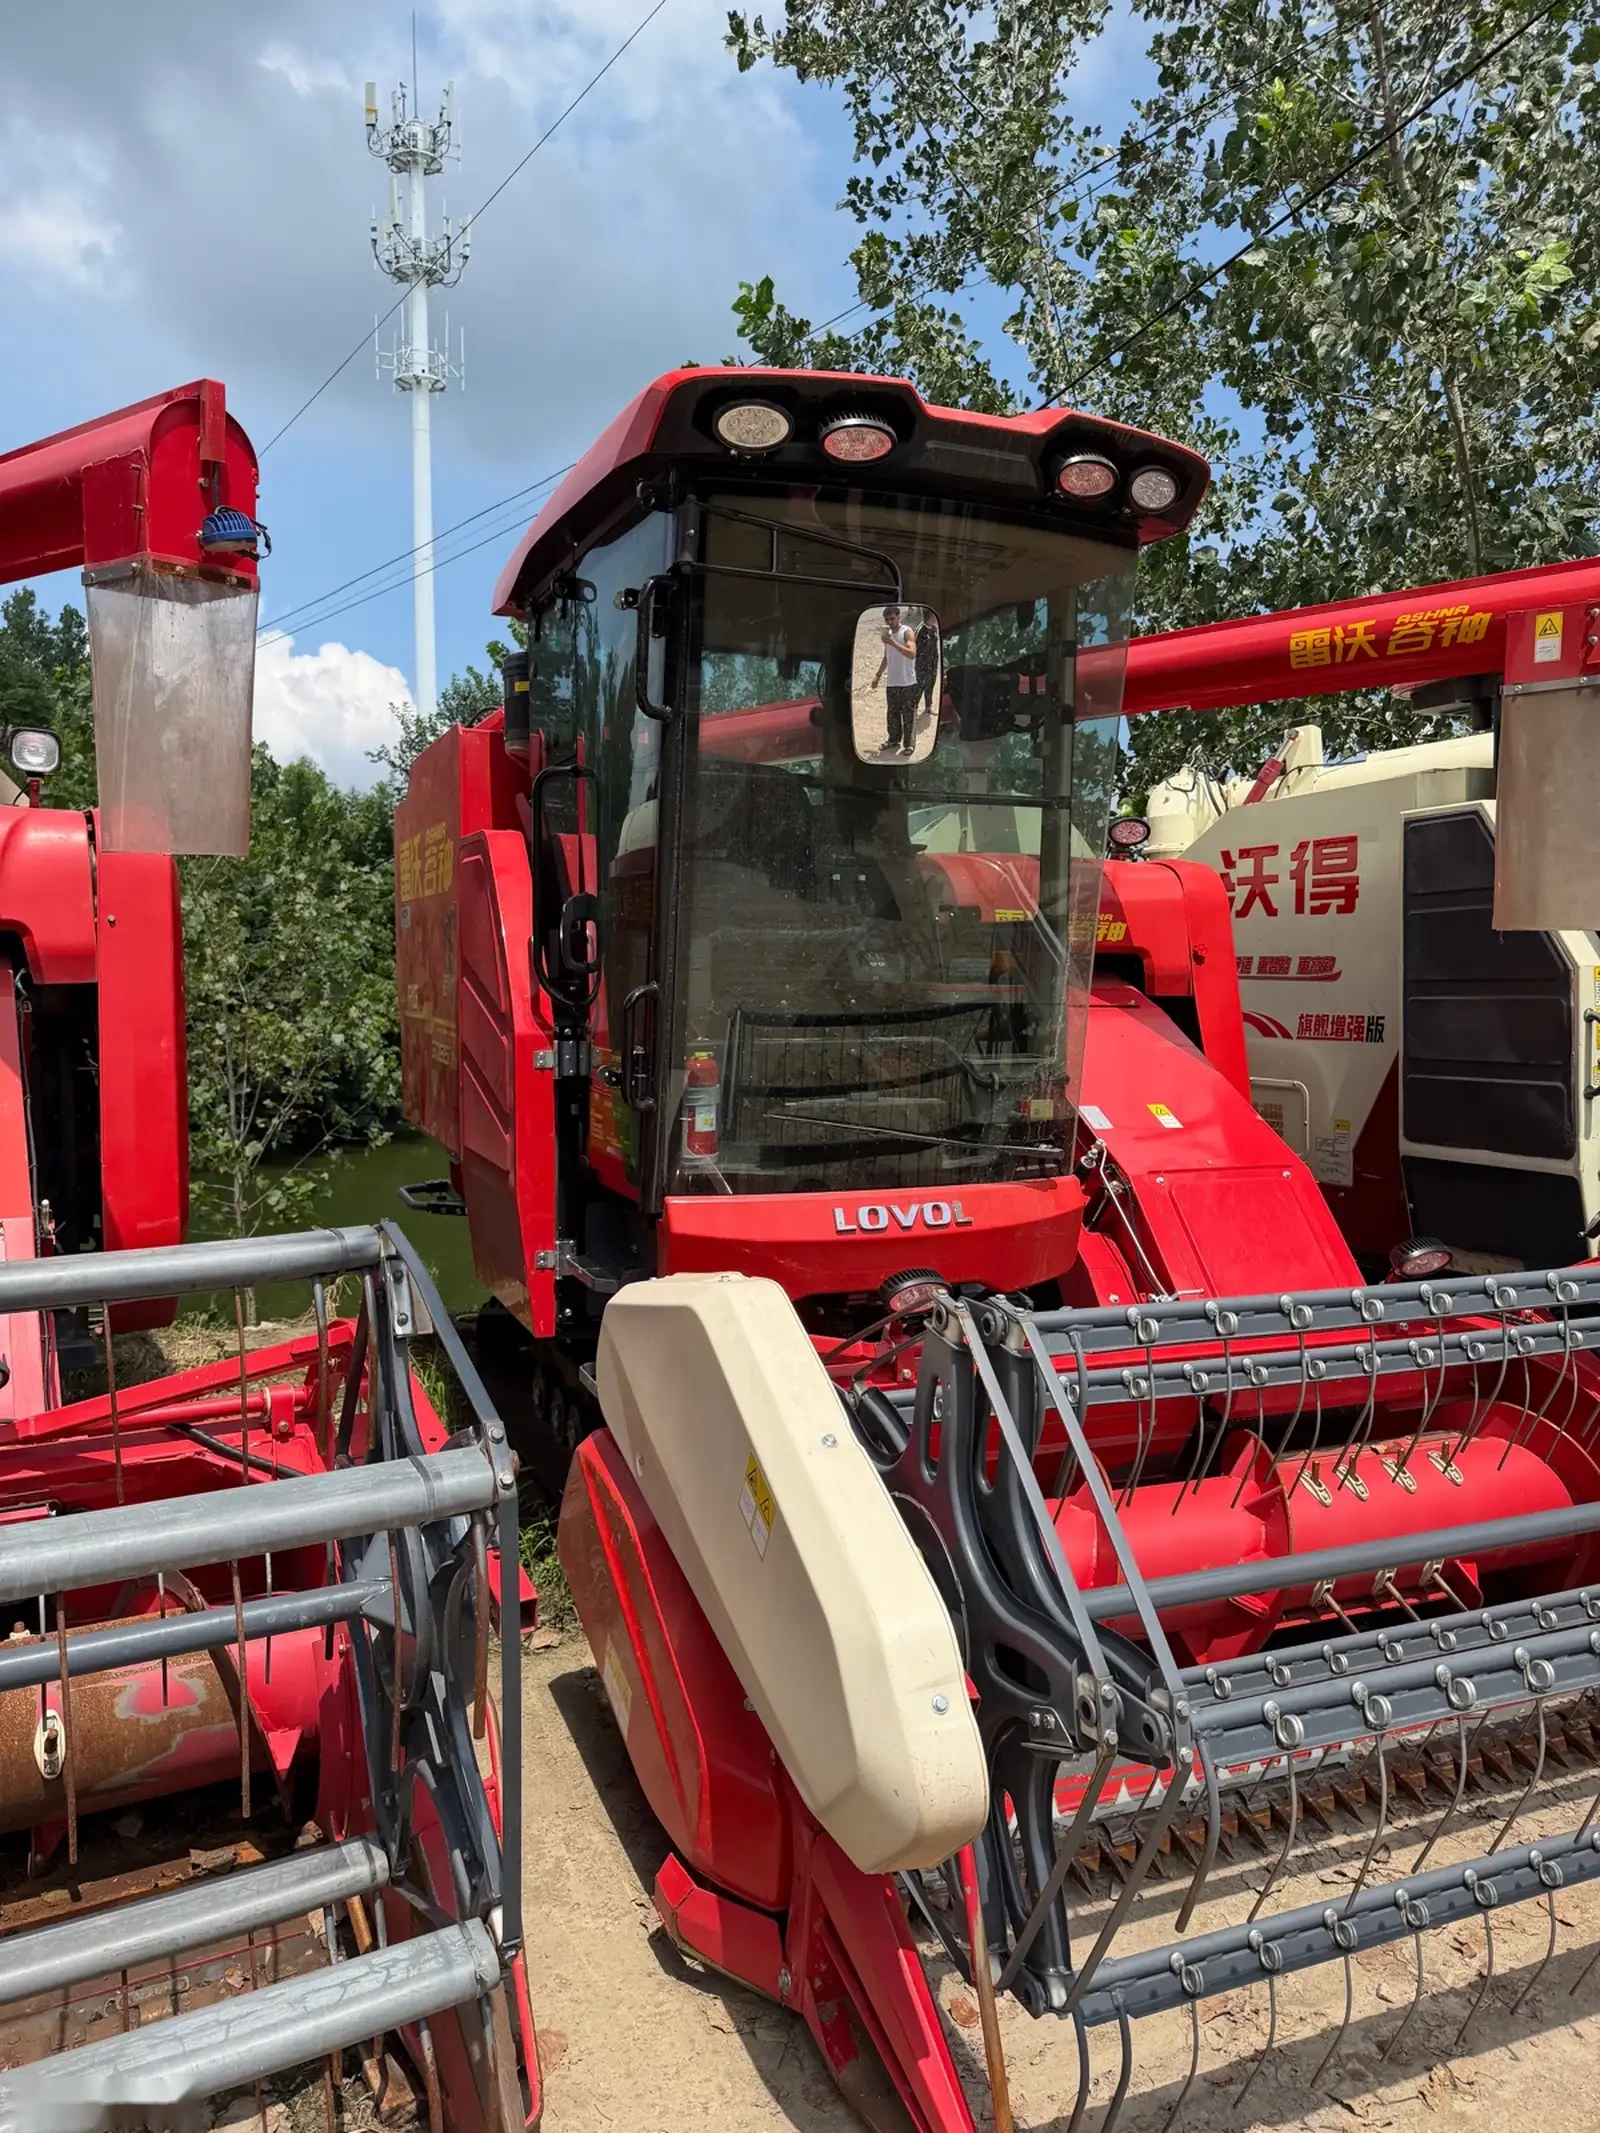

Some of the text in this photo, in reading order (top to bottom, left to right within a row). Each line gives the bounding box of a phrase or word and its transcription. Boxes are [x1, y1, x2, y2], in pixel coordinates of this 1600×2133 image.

[1395, 605, 1470, 625] ASHNA
[1289, 612, 1492, 669] 雷沃 谷神
[1219, 834, 1360, 919] 沃得
[1297, 1013, 1386, 1043] 旗舰增强版
[833, 1200, 974, 1236] LOVOL
